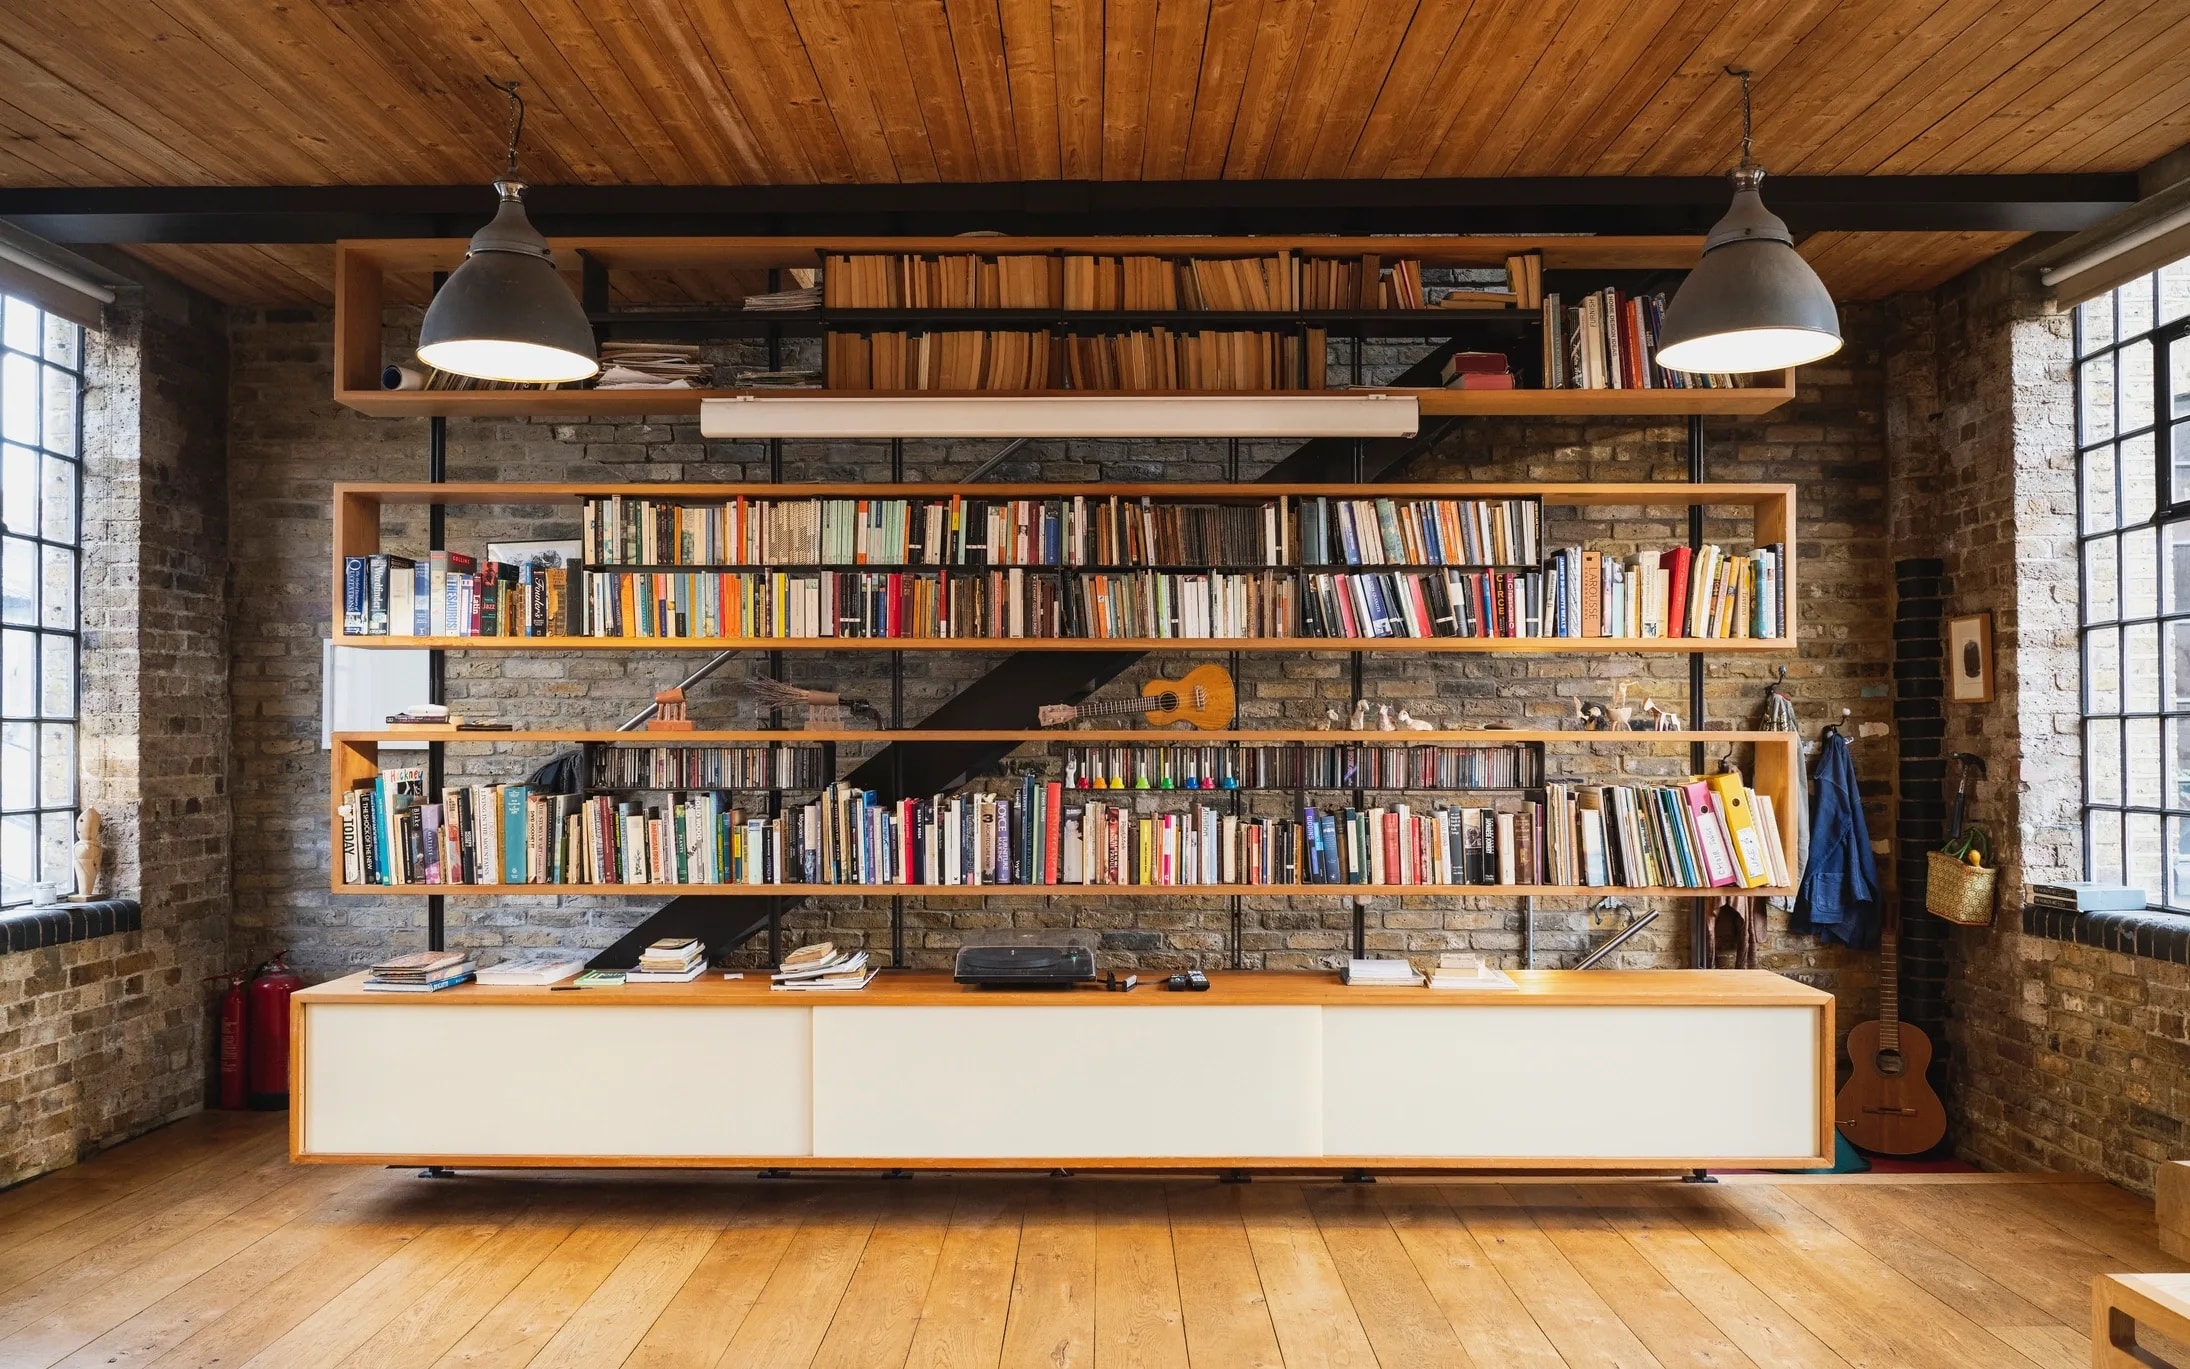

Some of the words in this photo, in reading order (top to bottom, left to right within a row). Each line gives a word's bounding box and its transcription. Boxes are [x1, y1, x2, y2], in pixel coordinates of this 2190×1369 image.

[1588, 299, 1597, 328] FURNISH
[452, 555, 470, 565] COLLINS
[346, 560, 362, 612] QUOTATIONS
[373, 566, 384, 609] Wordfinder
[534, 578, 544, 618] Fowler's
[1496, 575, 1504, 615] CIRCE
[1588, 567, 1598, 620] LAROUSSE
[1676, 554, 1686, 609] OTTOLENGHI
[446, 580, 458, 628] THESAURUS
[472, 594, 480, 614] Latin
[390, 770, 423, 782] Hockney
[982, 814, 994, 823] 3
[998, 803, 1007, 832] JOYCE
[343, 818, 355, 856] TODAY
[364, 834, 370, 842] OF
